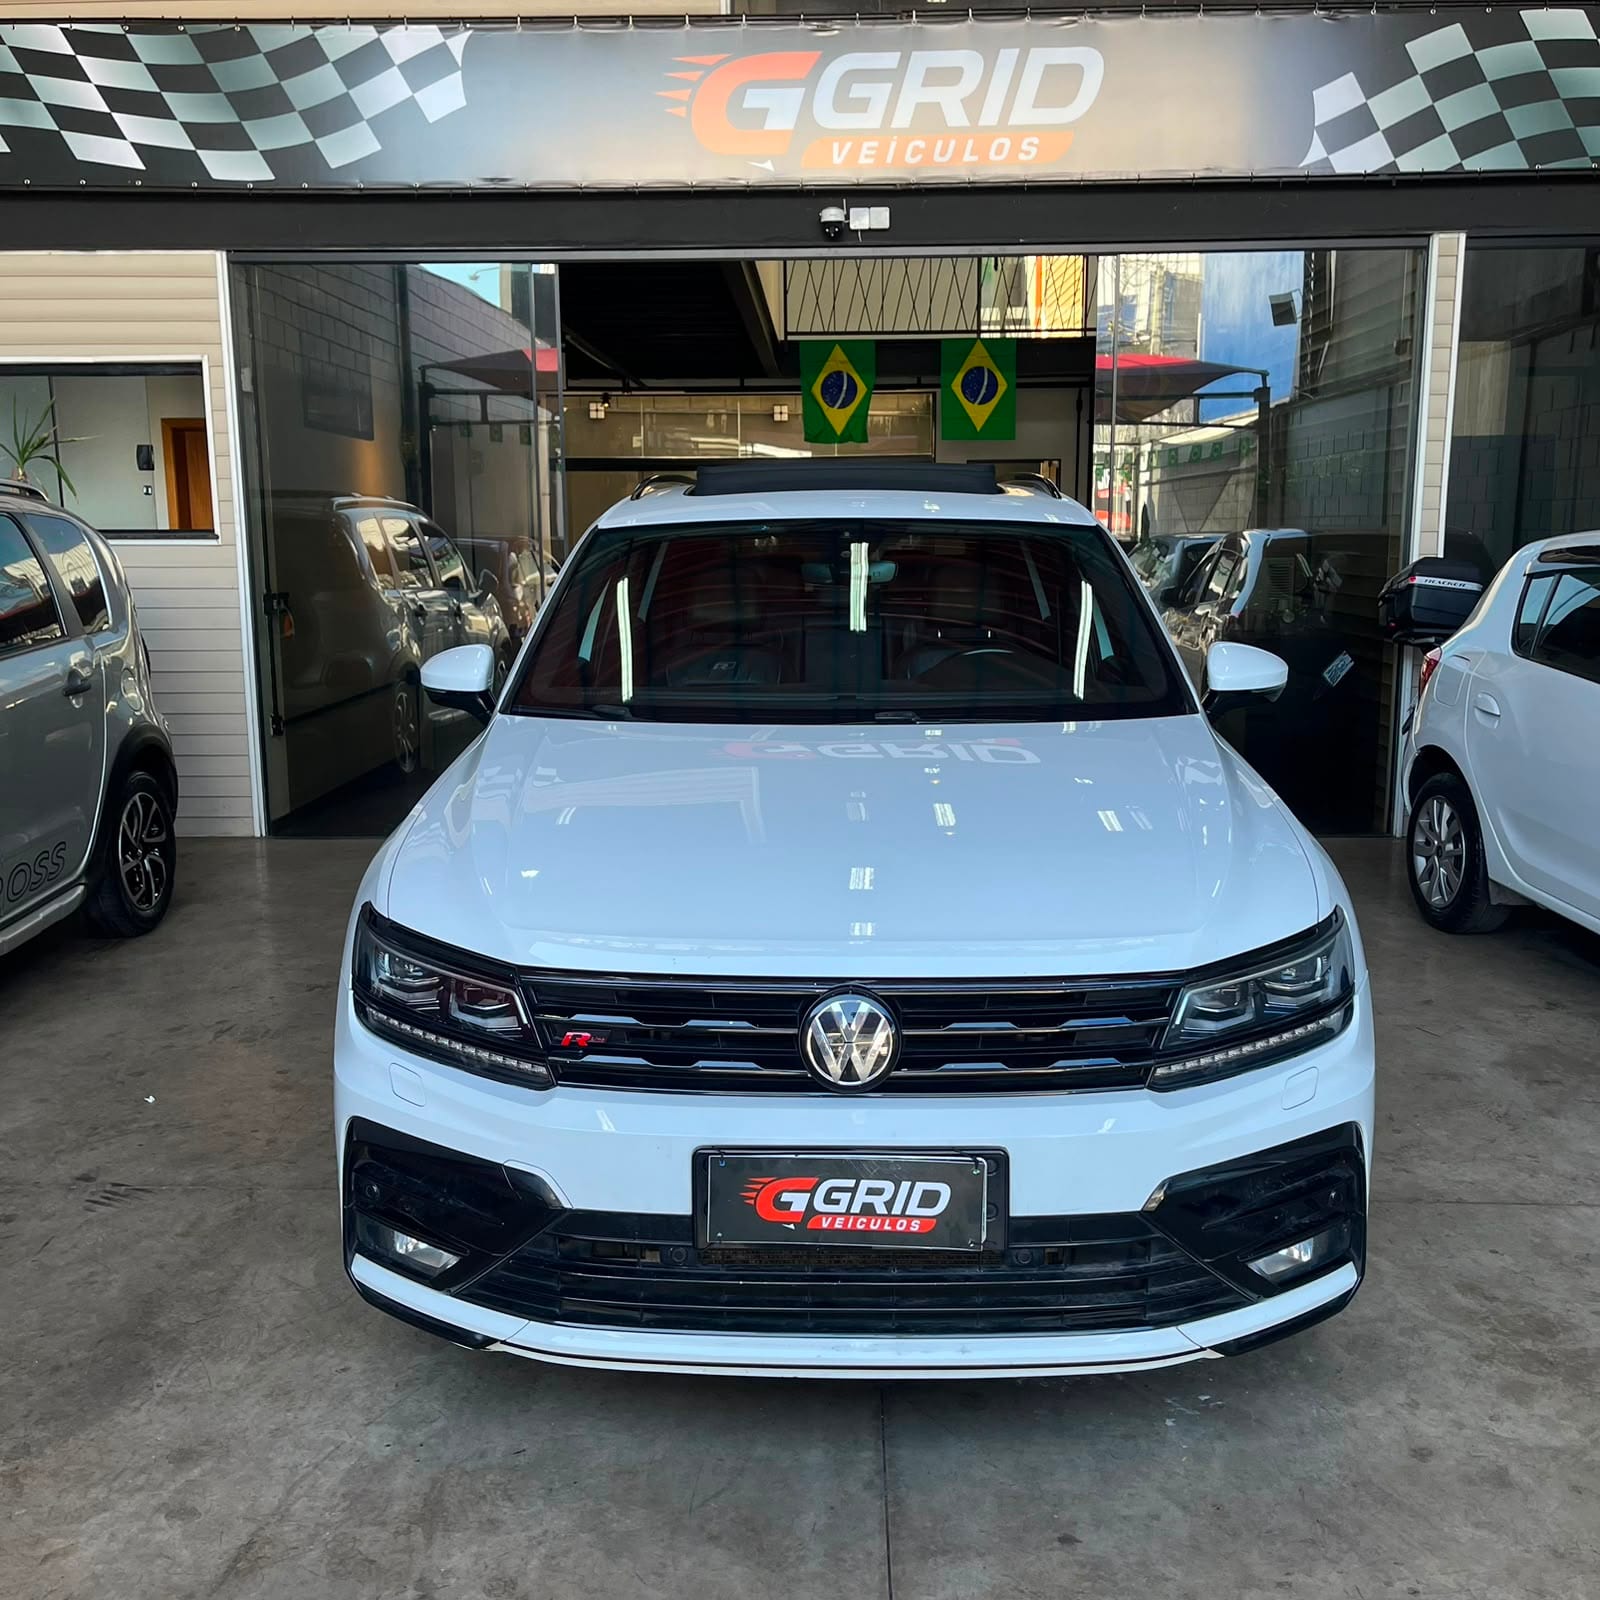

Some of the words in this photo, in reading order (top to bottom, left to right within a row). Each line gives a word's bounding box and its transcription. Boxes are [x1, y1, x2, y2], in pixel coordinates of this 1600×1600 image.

[830, 135, 1040, 165] VEÍCULOS
[0, 841, 67, 903] OSS
[821, 1215, 921, 1232] VEÍCULOS
